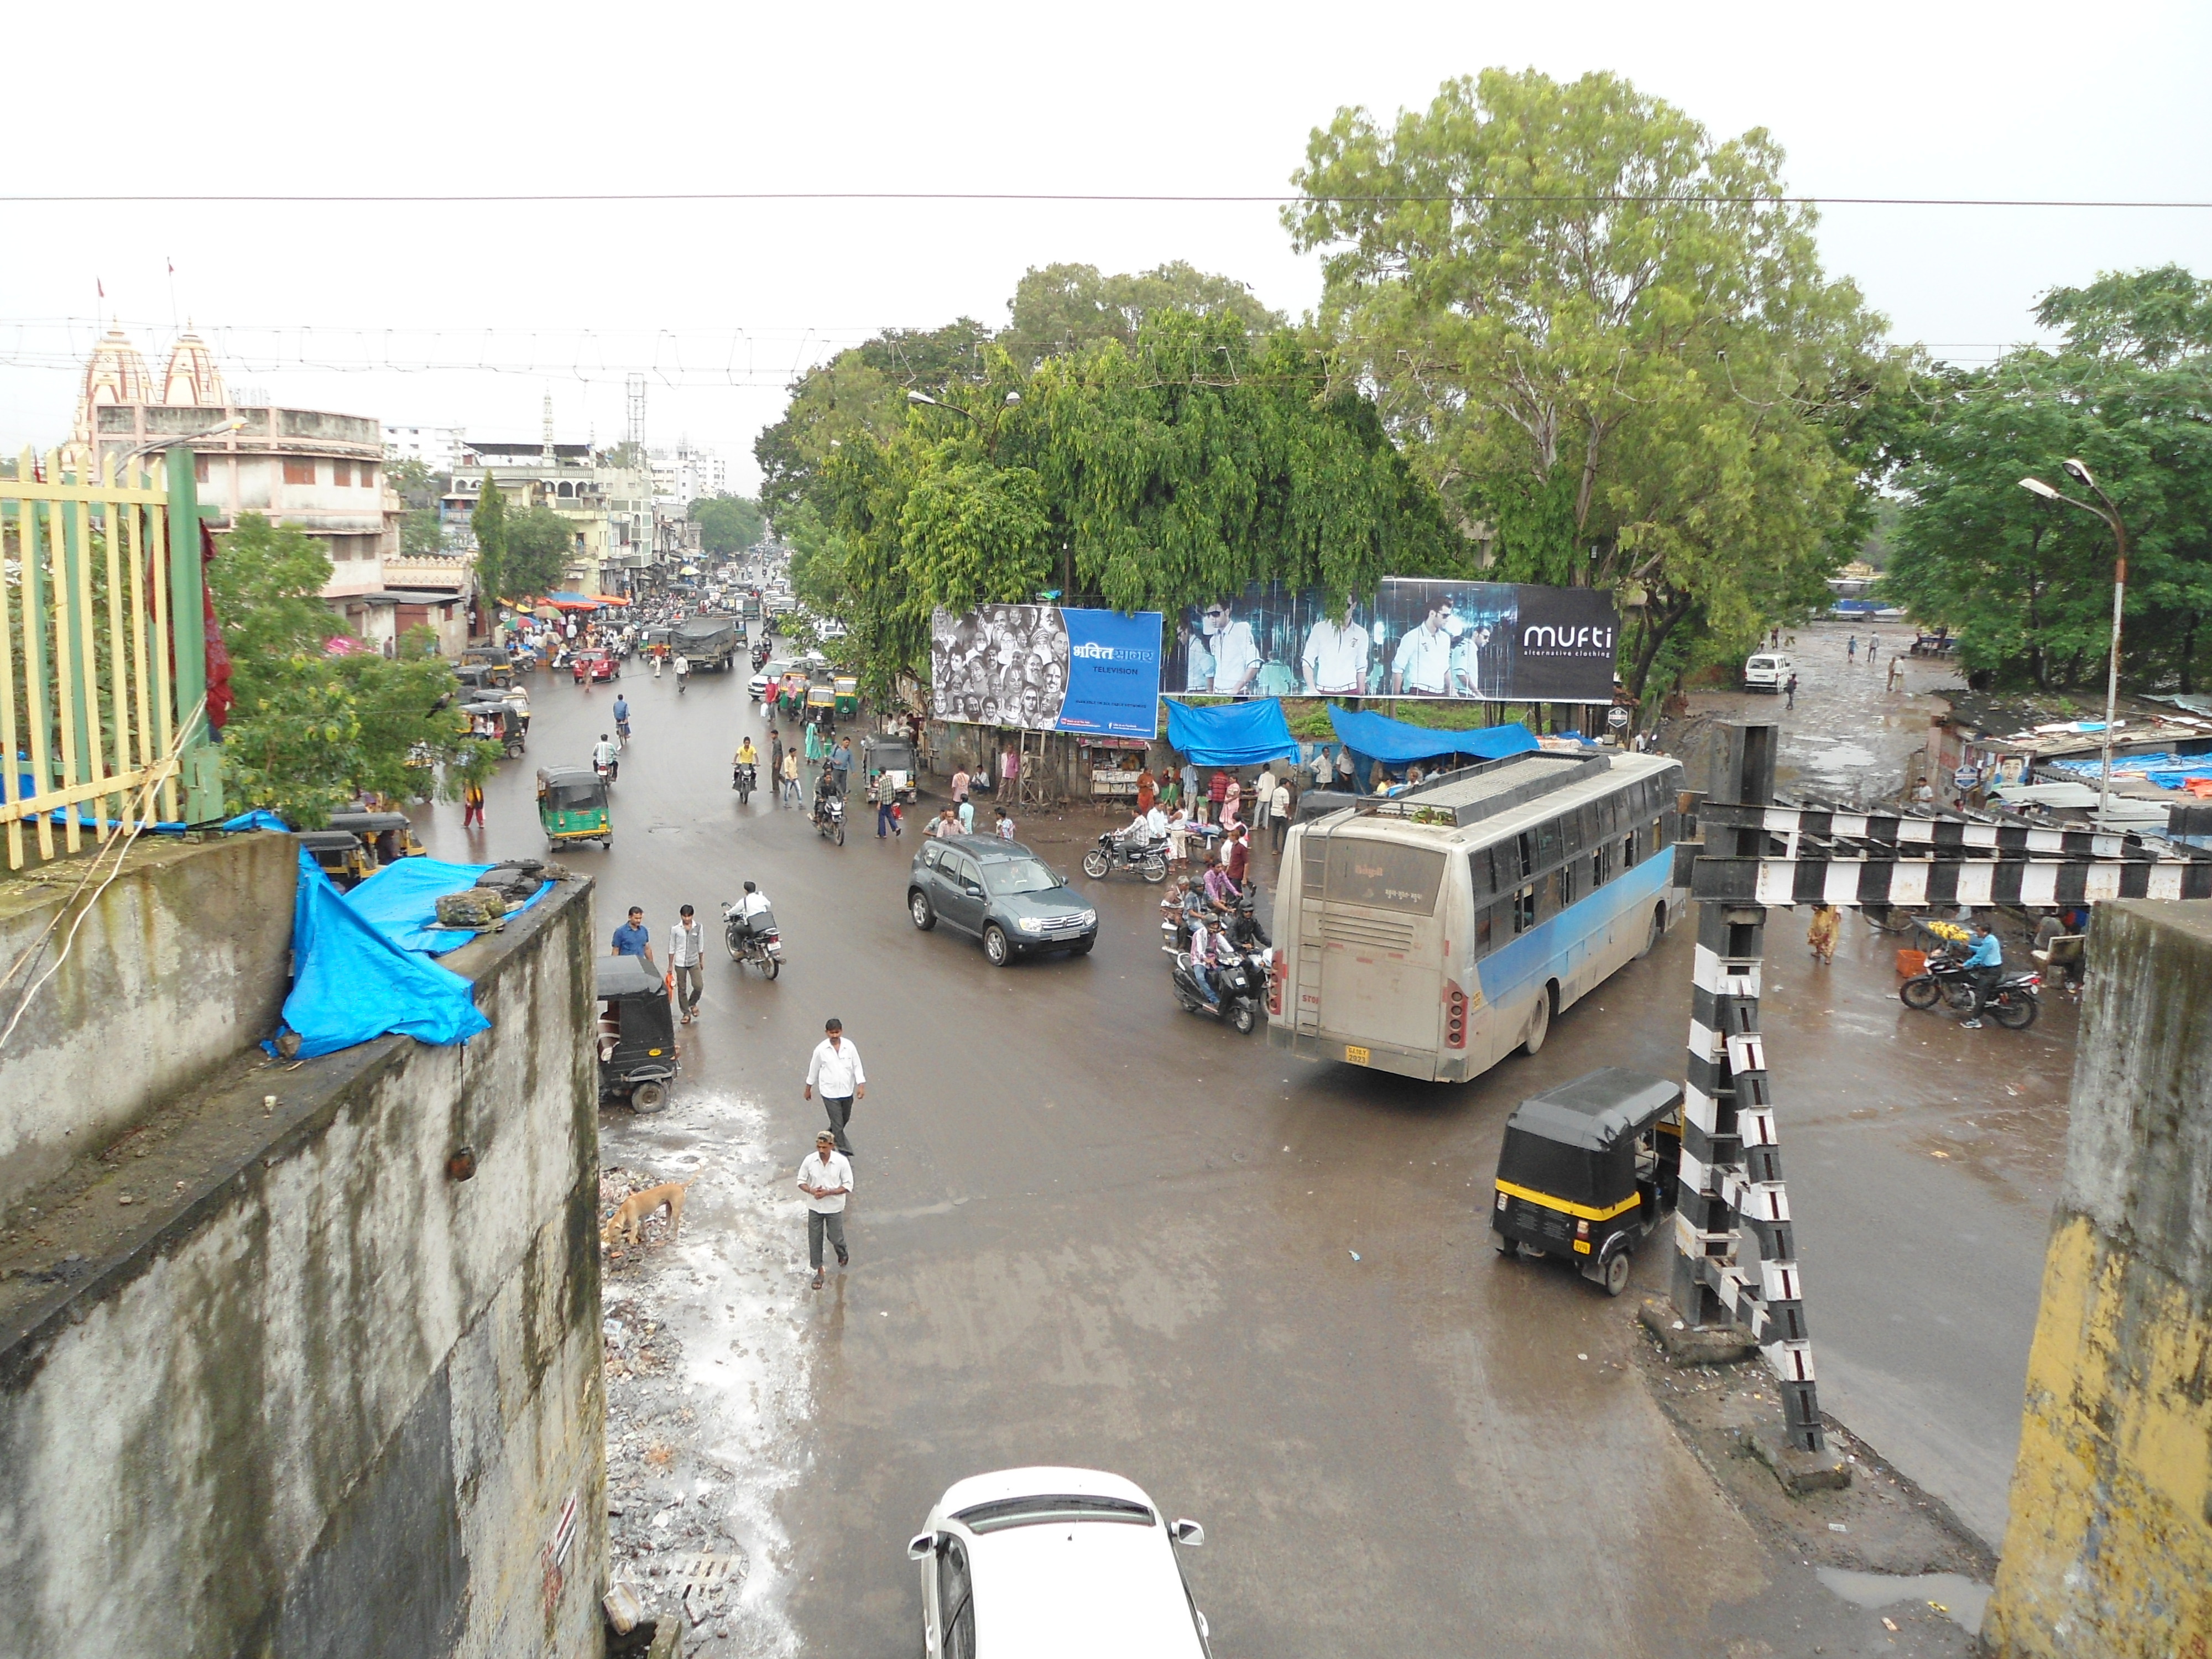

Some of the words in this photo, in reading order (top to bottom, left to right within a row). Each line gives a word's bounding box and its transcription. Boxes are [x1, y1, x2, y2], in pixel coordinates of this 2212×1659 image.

[1524, 626, 1611, 648] mufti
[1093, 666, 1138, 675] TELEVISION
[1348, 1055, 1366, 1063] 2923
